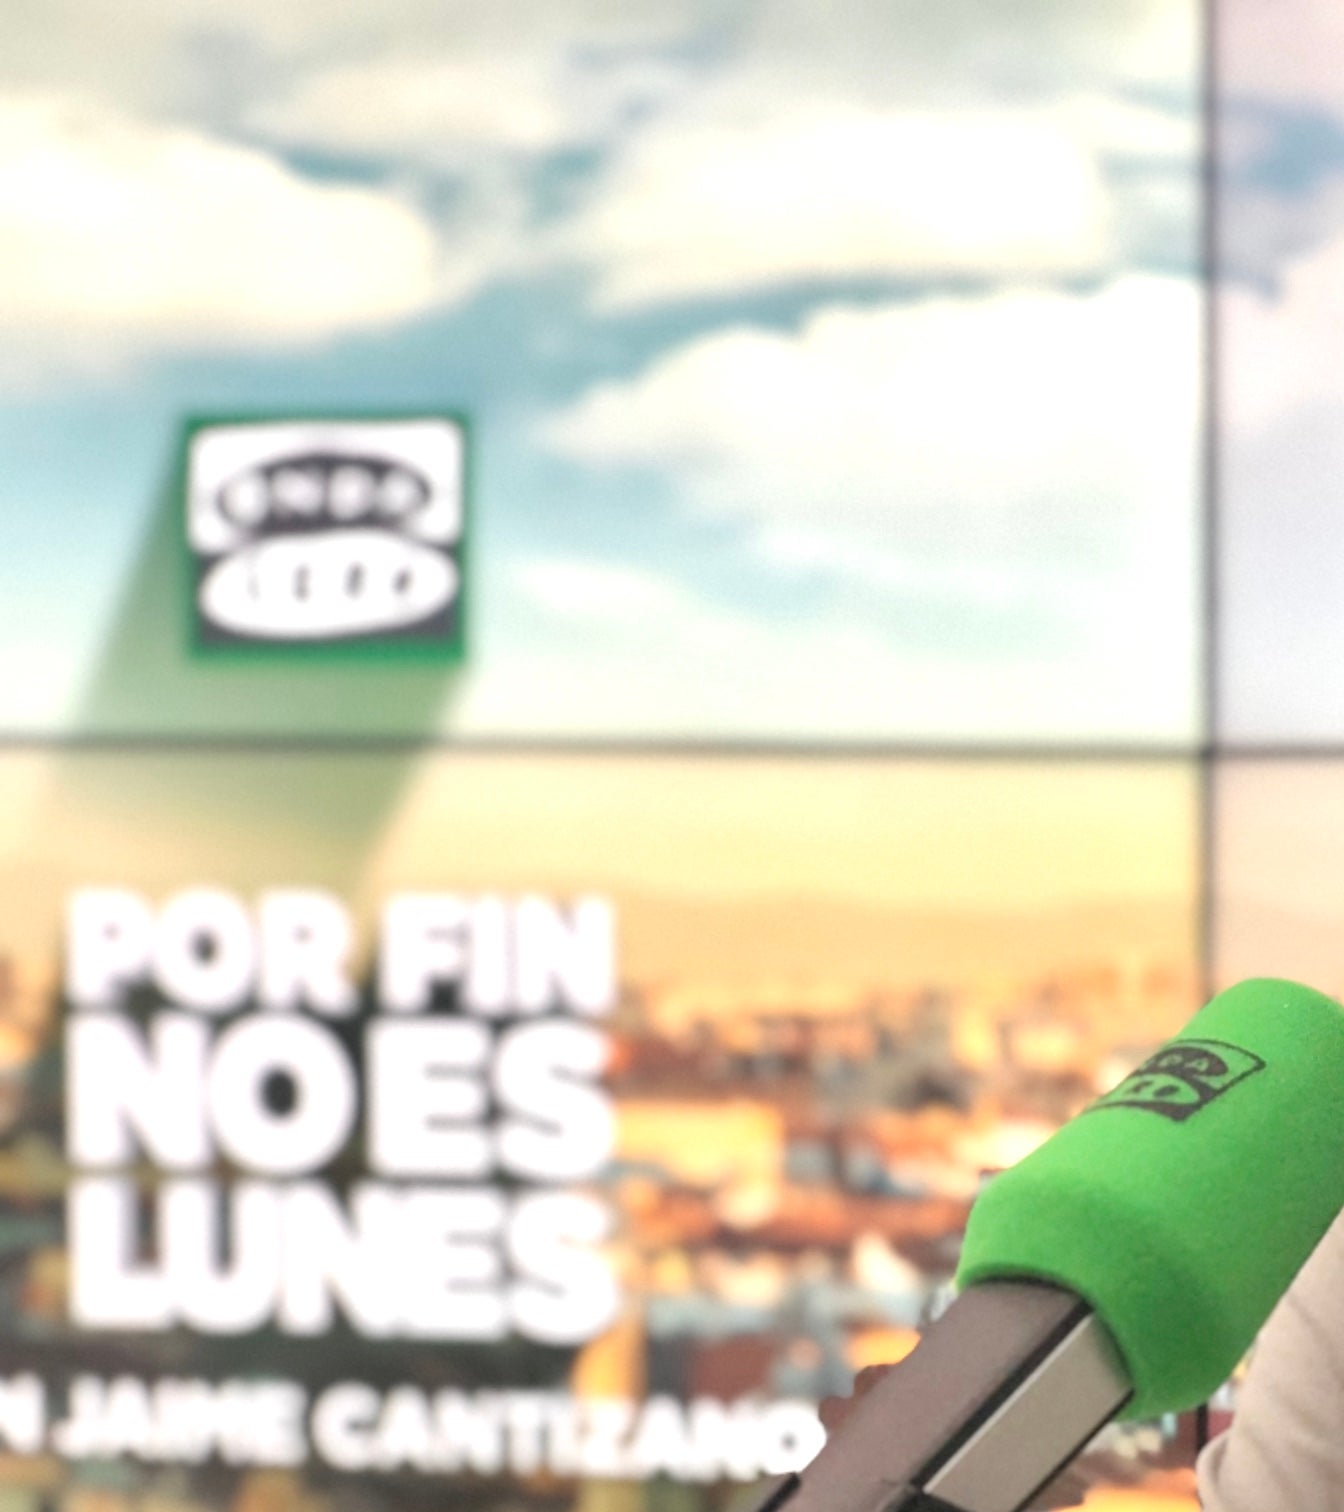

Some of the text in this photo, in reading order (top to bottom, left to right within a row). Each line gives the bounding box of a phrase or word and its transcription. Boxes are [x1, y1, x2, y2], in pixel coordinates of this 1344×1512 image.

[66, 886, 617, 1013] POR FIN
[66, 1012, 617, 1181] NO ES
[68, 1178, 619, 1342] LUNES
[55, 1374, 306, 1463] JAIME
